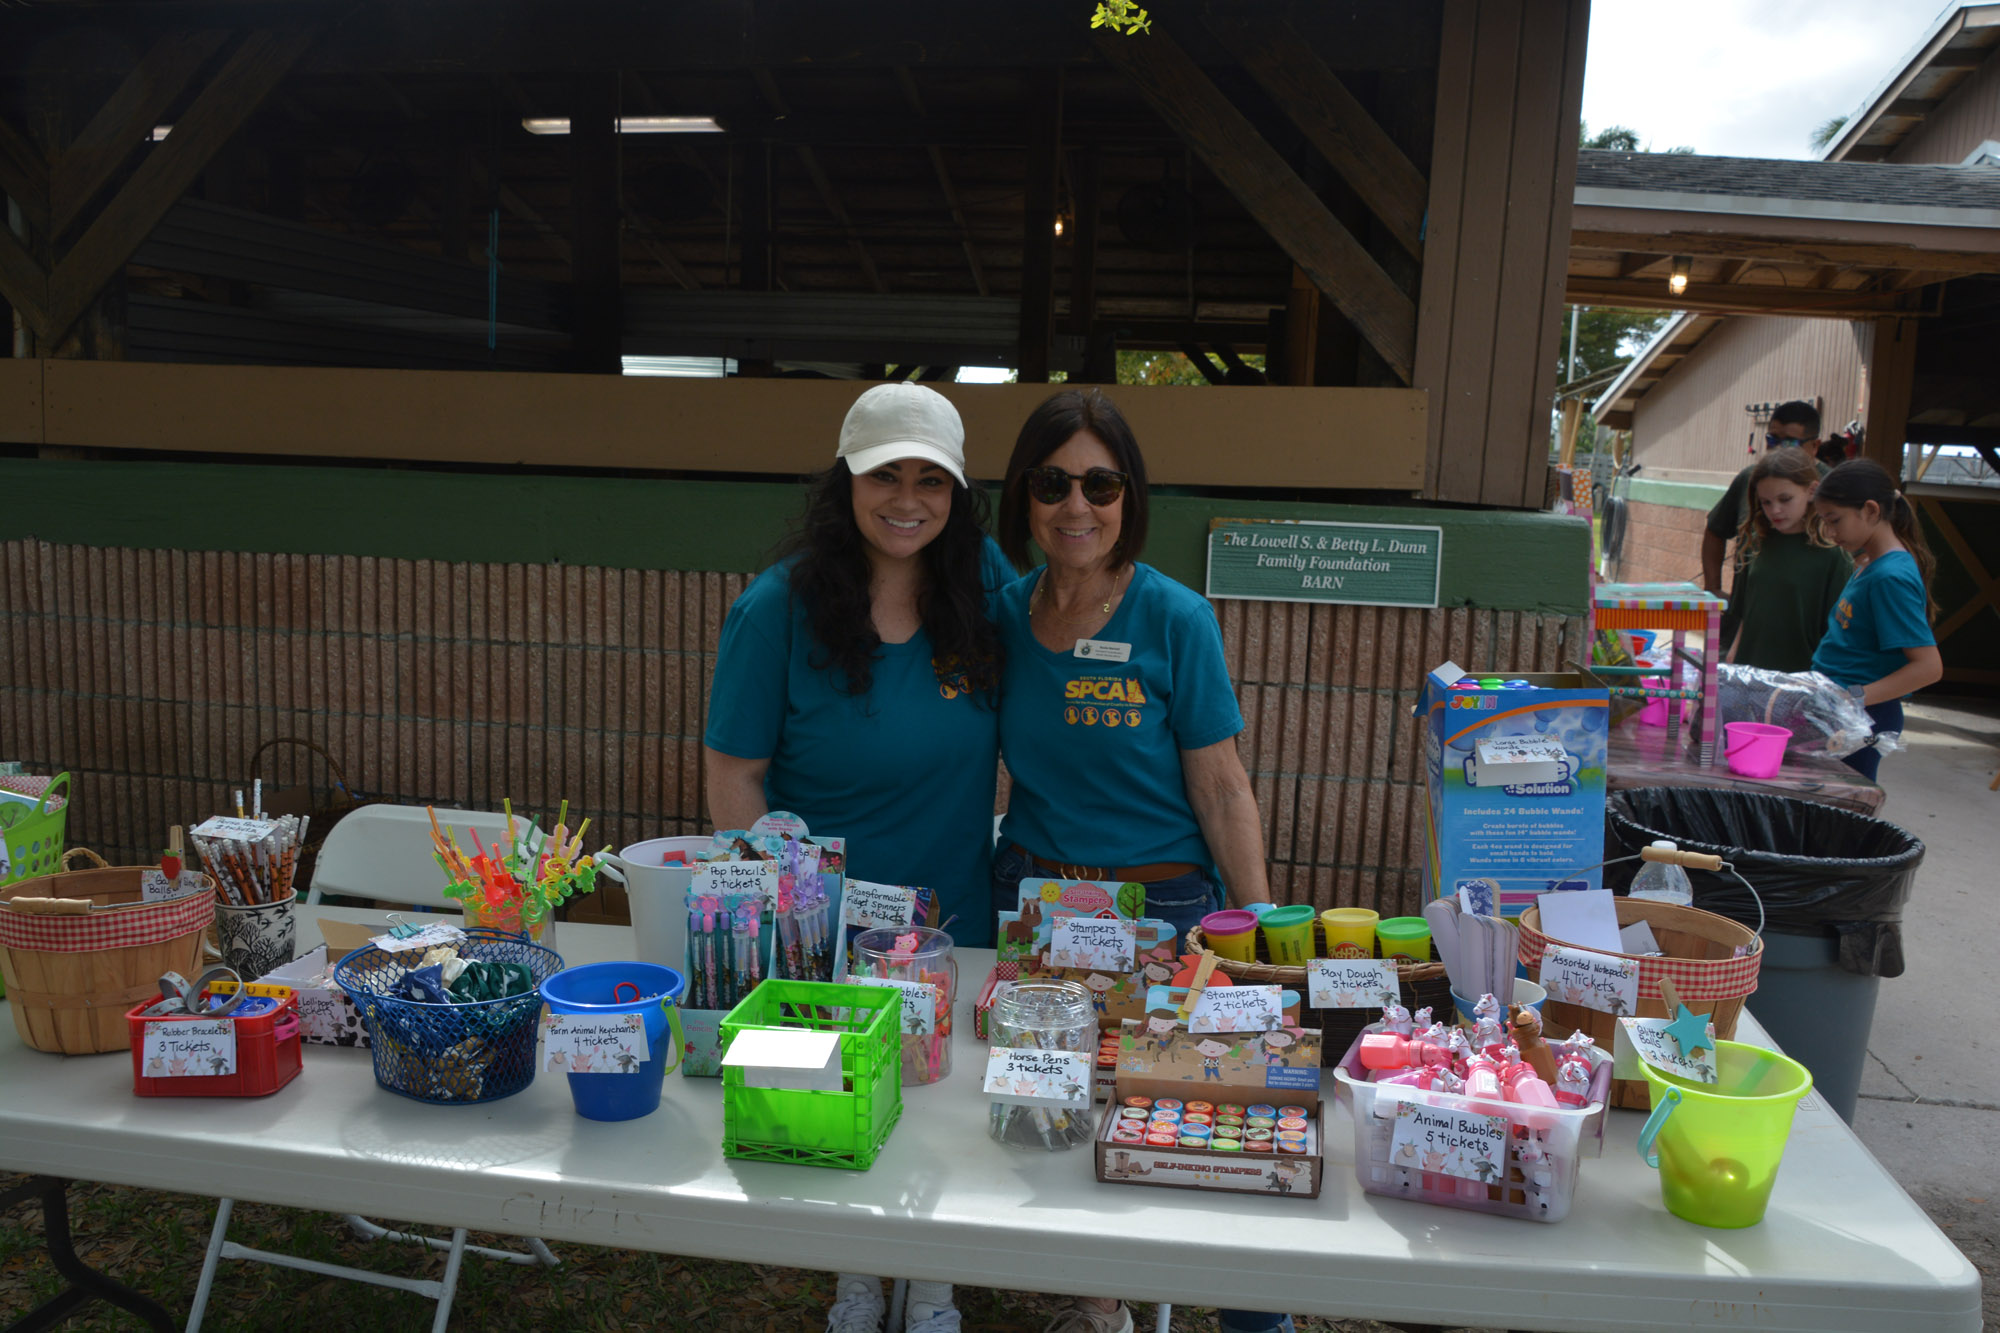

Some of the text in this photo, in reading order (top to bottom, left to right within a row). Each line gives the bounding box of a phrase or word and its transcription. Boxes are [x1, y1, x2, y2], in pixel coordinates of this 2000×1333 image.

[1223, 532, 1427, 555] The Lowell S. & Betty L. Dunn
[1256, 553, 1391, 572] Family Foundation
[1301, 575, 1345, 589] BARN
[1064, 680, 1127, 702] SPCA
[1449, 694, 1498, 710] JOYIN
[1515, 783, 1570, 795] Solution
[1463, 807, 1585, 816] Includes 24 Bubble Wands!
[710, 866, 727, 878] Pop
[731, 865, 767, 877] Pencils
[147, 883, 172, 894] Balls
[710, 877, 761, 889] 5 tickets
[849, 885, 908, 903] Transformable
[1063, 894, 1108, 905] Stampers
[871, 900, 906, 912] Spinners
[861, 910, 868, 918] 5
[1069, 922, 1117, 936] Stampers
[1072, 935, 1080, 945] 2
[1552, 954, 1629, 980] Assorted Notepads
[1320, 967, 1383, 982] Play Dough
[1562, 969, 1570, 985] 4
[1332, 979, 1379, 989] 5 tickets
[1206, 989, 1259, 1000] Stampers
[1213, 997, 1268, 1012] 2 tickets
[161, 1026, 228, 1037] Rubber Bracelets
[551, 1026, 569, 1036] Farm
[570, 1024, 597, 1035] Animal
[159, 1041, 167, 1052] 3
[574, 1035, 619, 1047] 4 tickets
[1639, 1033, 1662, 1049] Balls
[1009, 1052, 1070, 1065] Horse Pens
[1660, 1051, 1694, 1070] tickets
[1006, 1061, 1063, 1075] 3 tickets
[1413, 1111, 1504, 1141] Animal Bubbles
[1425, 1130, 1490, 1152] 5 tickets
[1153, 1160, 1263, 1176] SELF-INKING STAMPERS
